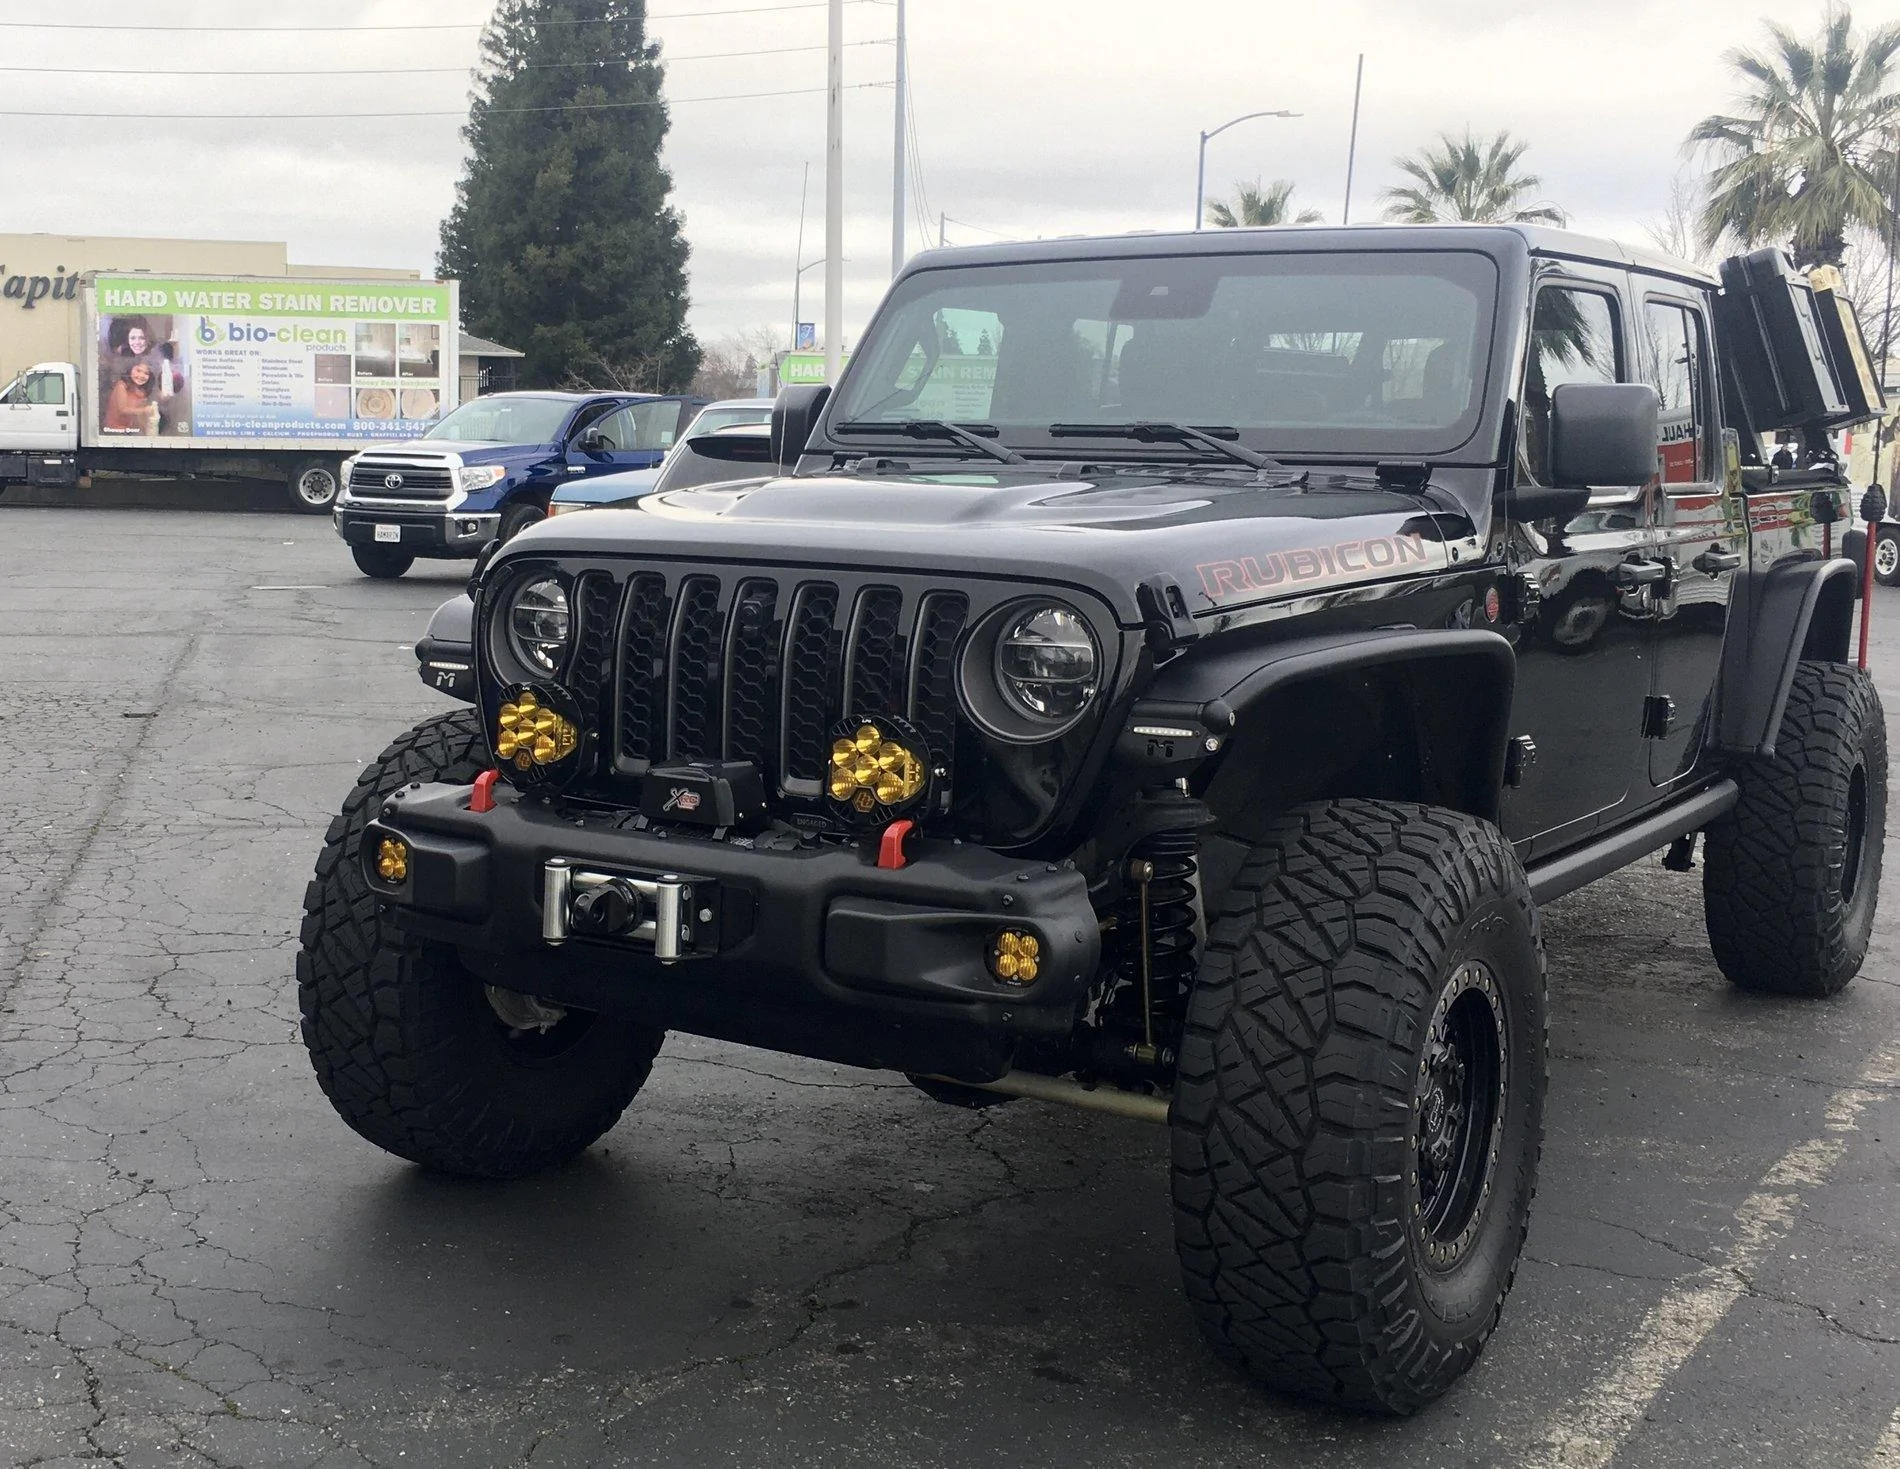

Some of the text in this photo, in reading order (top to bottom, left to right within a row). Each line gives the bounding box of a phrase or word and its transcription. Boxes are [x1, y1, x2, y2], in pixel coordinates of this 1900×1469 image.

[0, 264, 80, 309] apit
[104, 289, 437, 314] HARD WATER STAIN REMOVER
[229, 322, 347, 344] bio-clean
[306, 343, 347, 353] products
[197, 420, 346, 430] www.bio-cleanproducts.com
[1196, 533, 1427, 598] RUBICON
